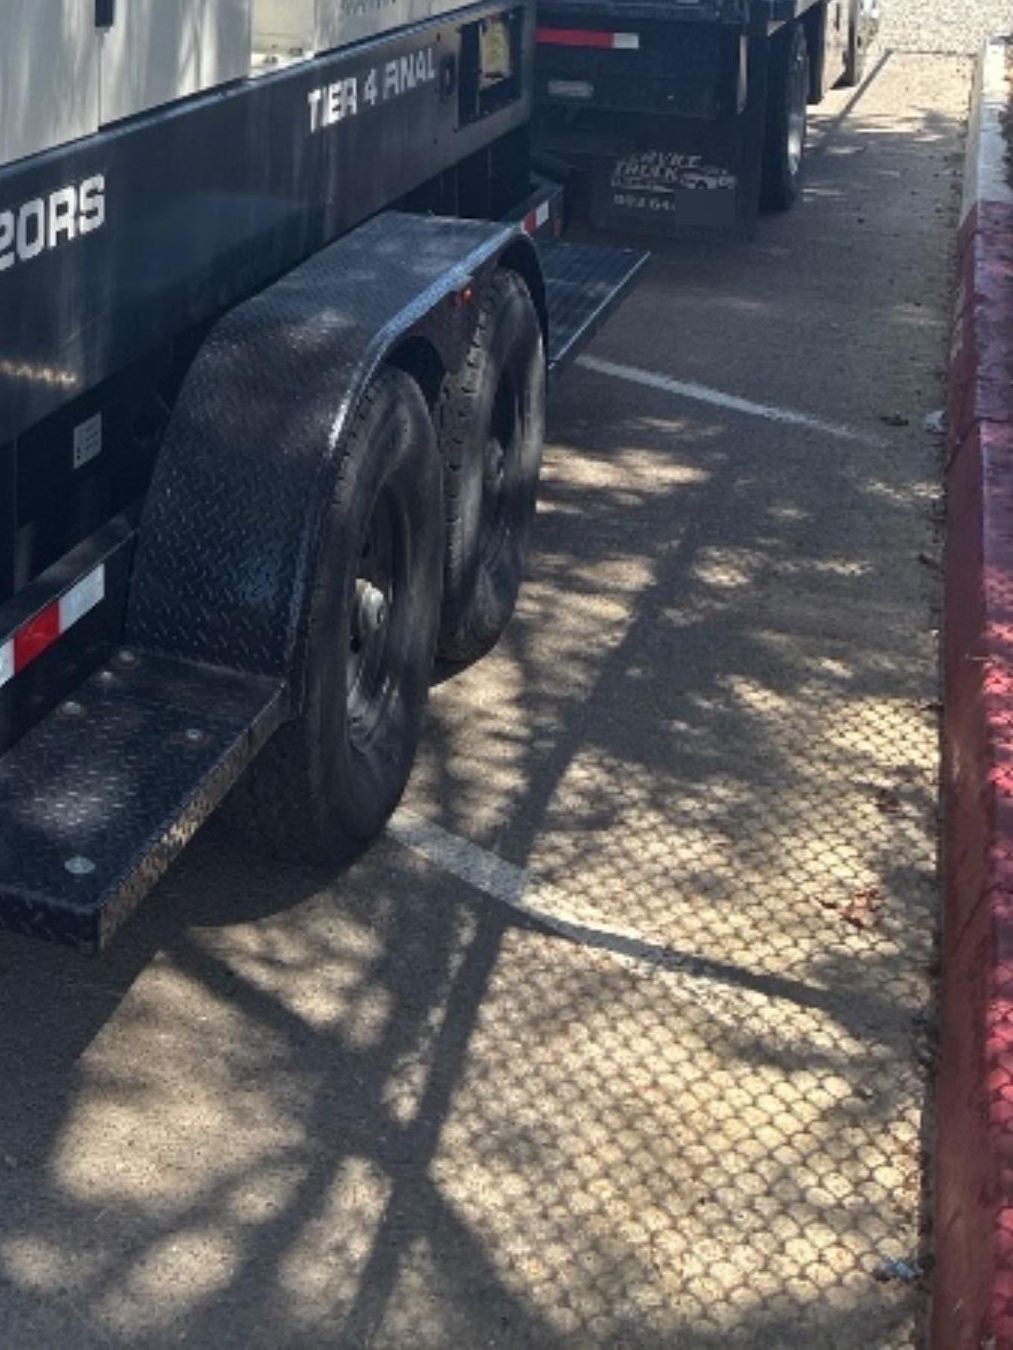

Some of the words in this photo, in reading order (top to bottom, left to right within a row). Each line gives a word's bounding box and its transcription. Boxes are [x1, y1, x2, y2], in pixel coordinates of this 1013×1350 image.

[307, 77, 357, 133] TIER
[363, 68, 378, 106] 4
[383, 47, 436, 101] FINAL
